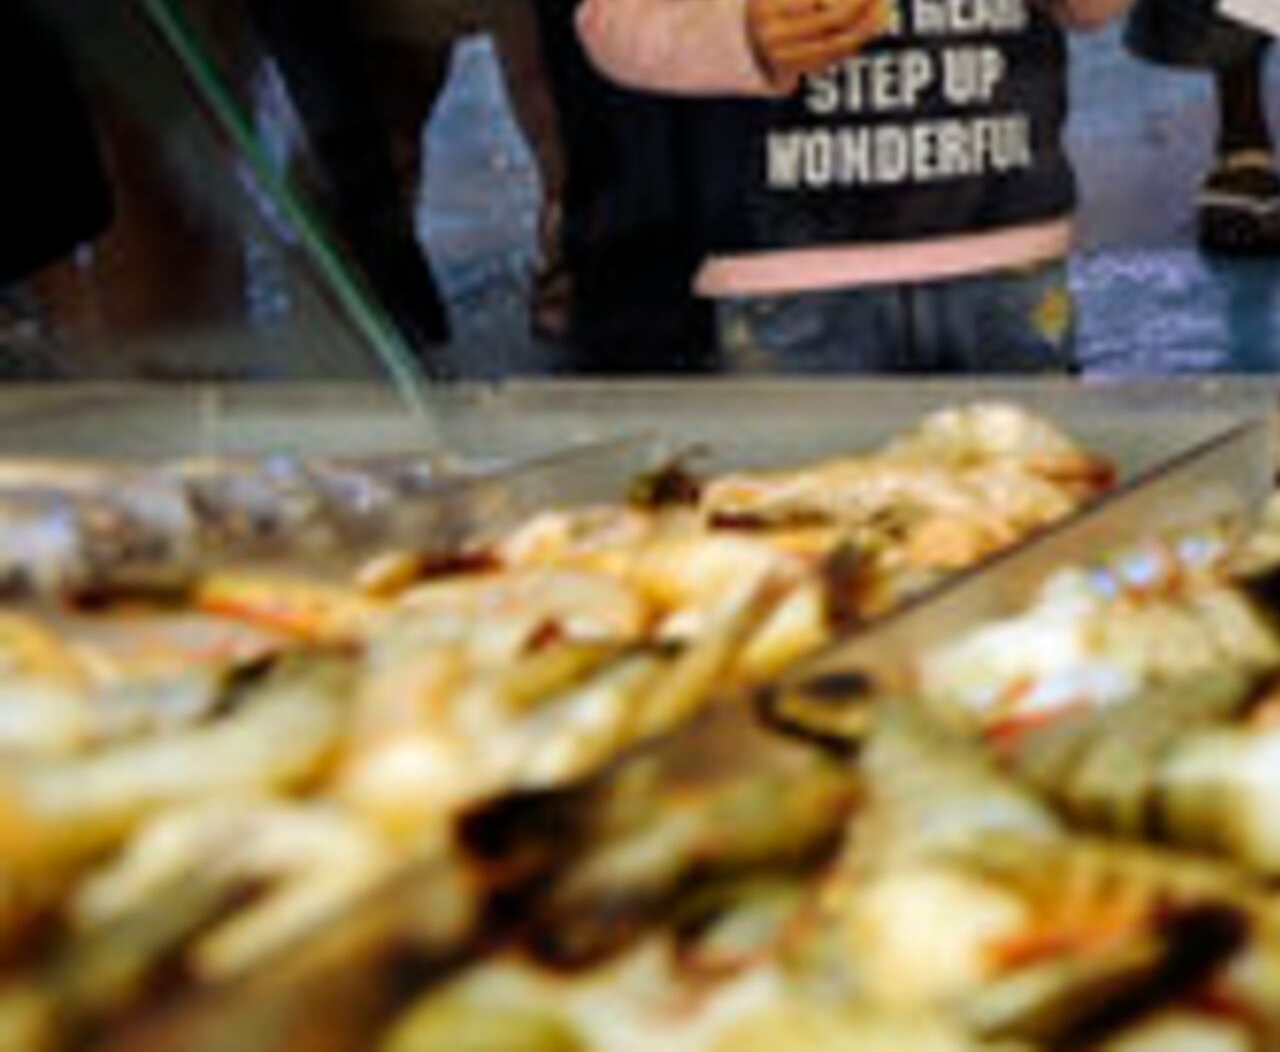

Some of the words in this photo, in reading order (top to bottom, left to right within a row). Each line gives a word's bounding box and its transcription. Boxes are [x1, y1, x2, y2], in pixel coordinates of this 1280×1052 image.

[805, 50, 934, 114] STEP
[942, 46, 1004, 102] UP
[766, 116, 1031, 190] WONDERFUL
